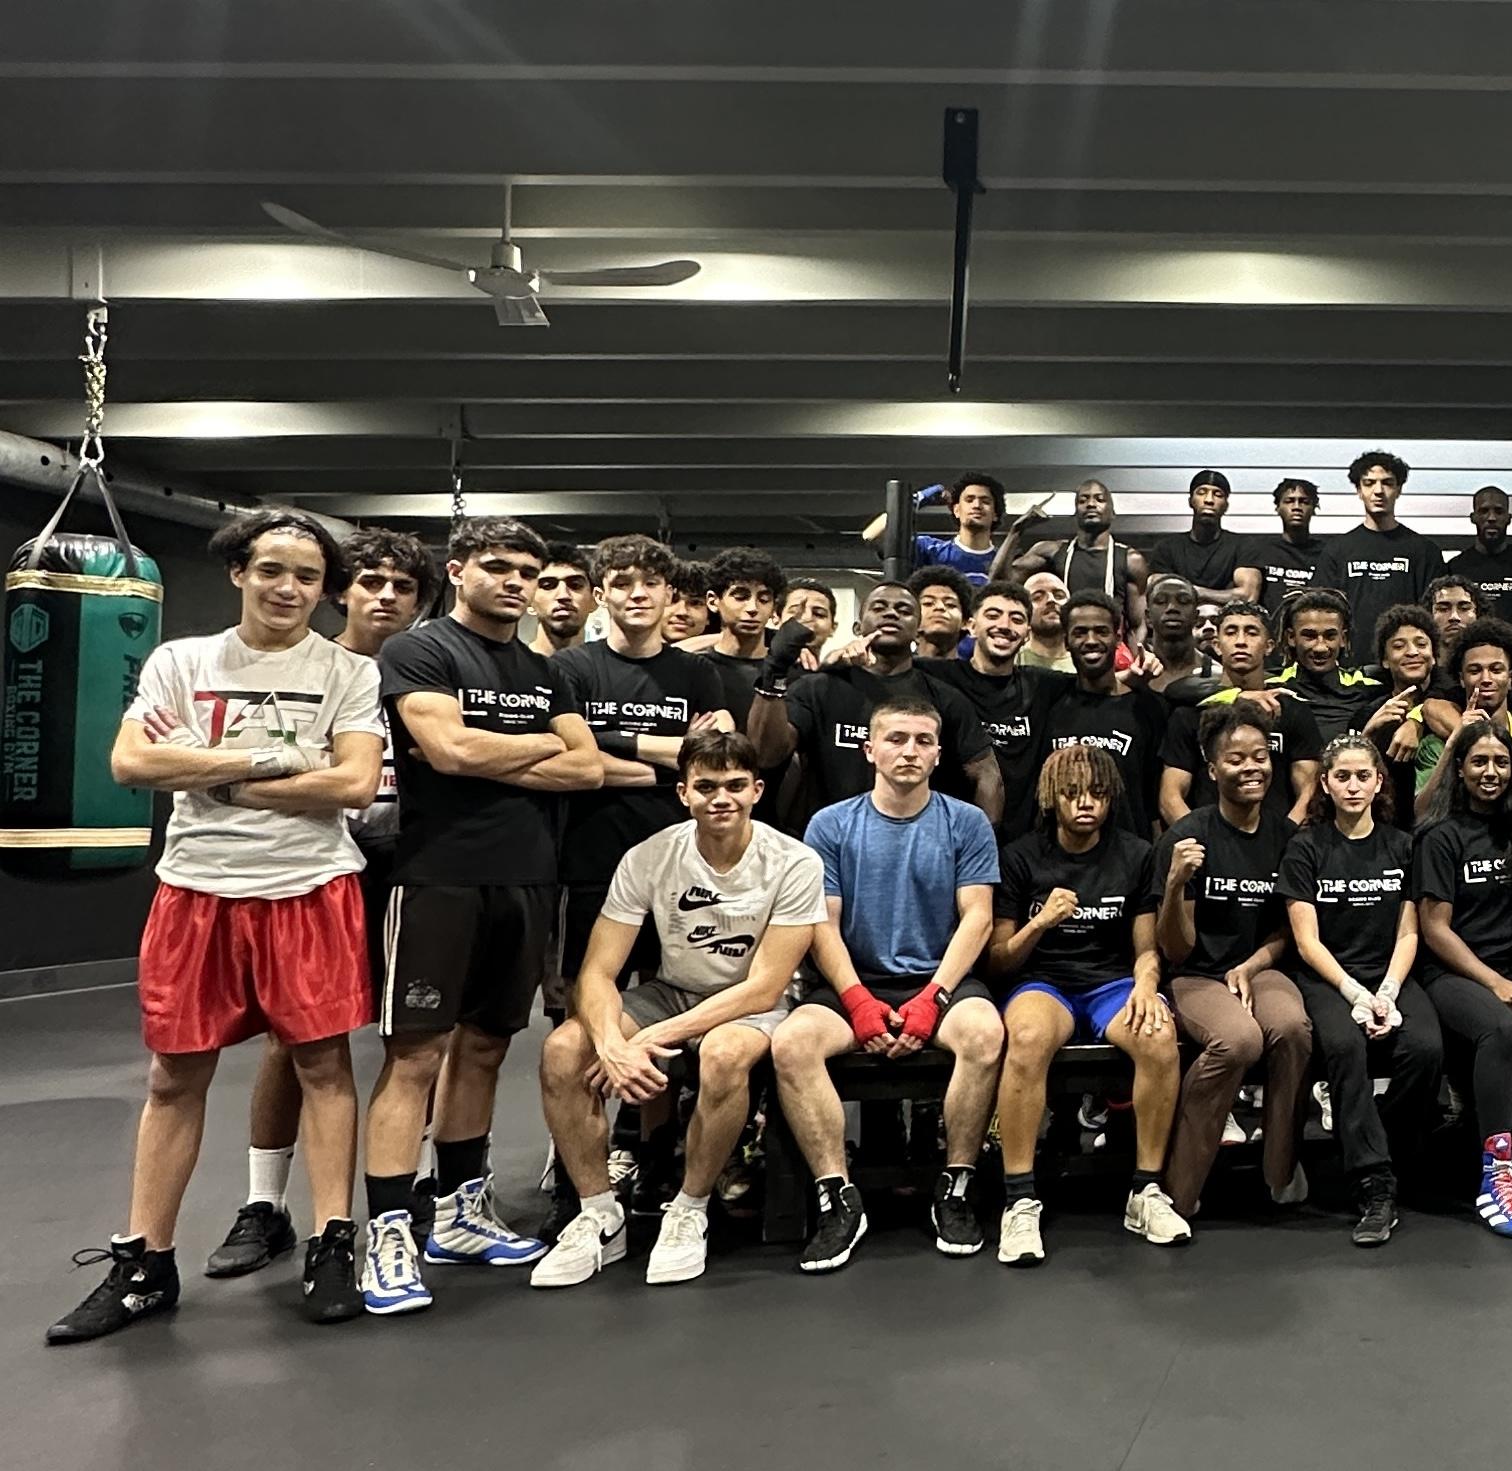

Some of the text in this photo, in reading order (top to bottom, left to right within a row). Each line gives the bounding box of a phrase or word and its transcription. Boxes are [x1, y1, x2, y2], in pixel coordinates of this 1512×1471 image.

[17, 660, 43, 704] THE
[467, 688, 497, 705] THE
[4, 685, 17, 738] BOXING
[591, 702, 683, 720] THE CORNER
[843, 724, 868, 738] THE
[13, 711, 41, 801] CORNER
[1470, 860, 1492, 874] THE
[1213, 877, 1275, 894] THE CORN
[1322, 878, 1402, 892] THE CORNER
[1072, 906, 1120, 920] ORNER
